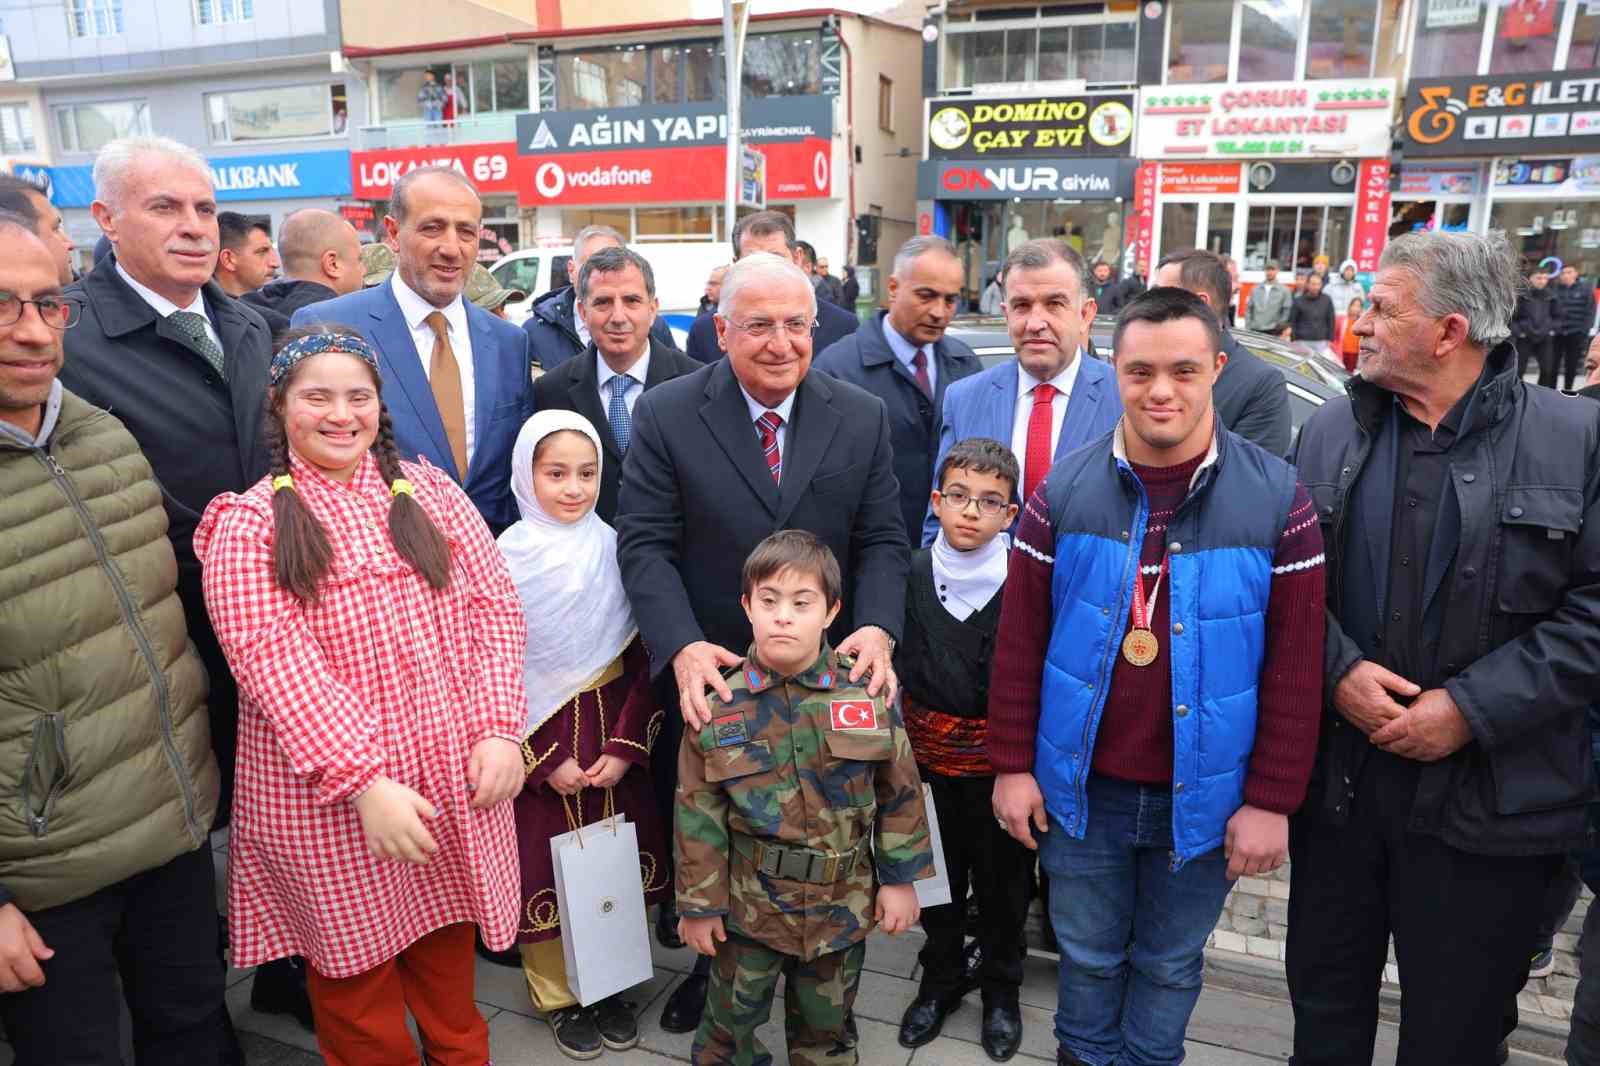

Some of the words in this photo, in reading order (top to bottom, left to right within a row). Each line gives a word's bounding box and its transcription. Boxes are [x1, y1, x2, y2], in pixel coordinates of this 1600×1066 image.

[1468, 82, 1527, 109] E&G
[971, 99, 1087, 124] DOMİNO
[568, 114, 645, 147] AĞIN
[652, 115, 727, 142] YAPI
[973, 129, 1029, 152] ÇAY
[1033, 124, 1086, 148] EVİ
[1176, 120, 1205, 137] ET
[210, 163, 301, 191] ALKBANK
[473, 154, 508, 181] 69
[567, 165, 652, 188] vodafone
[1062, 174, 1110, 191] GİYİM
